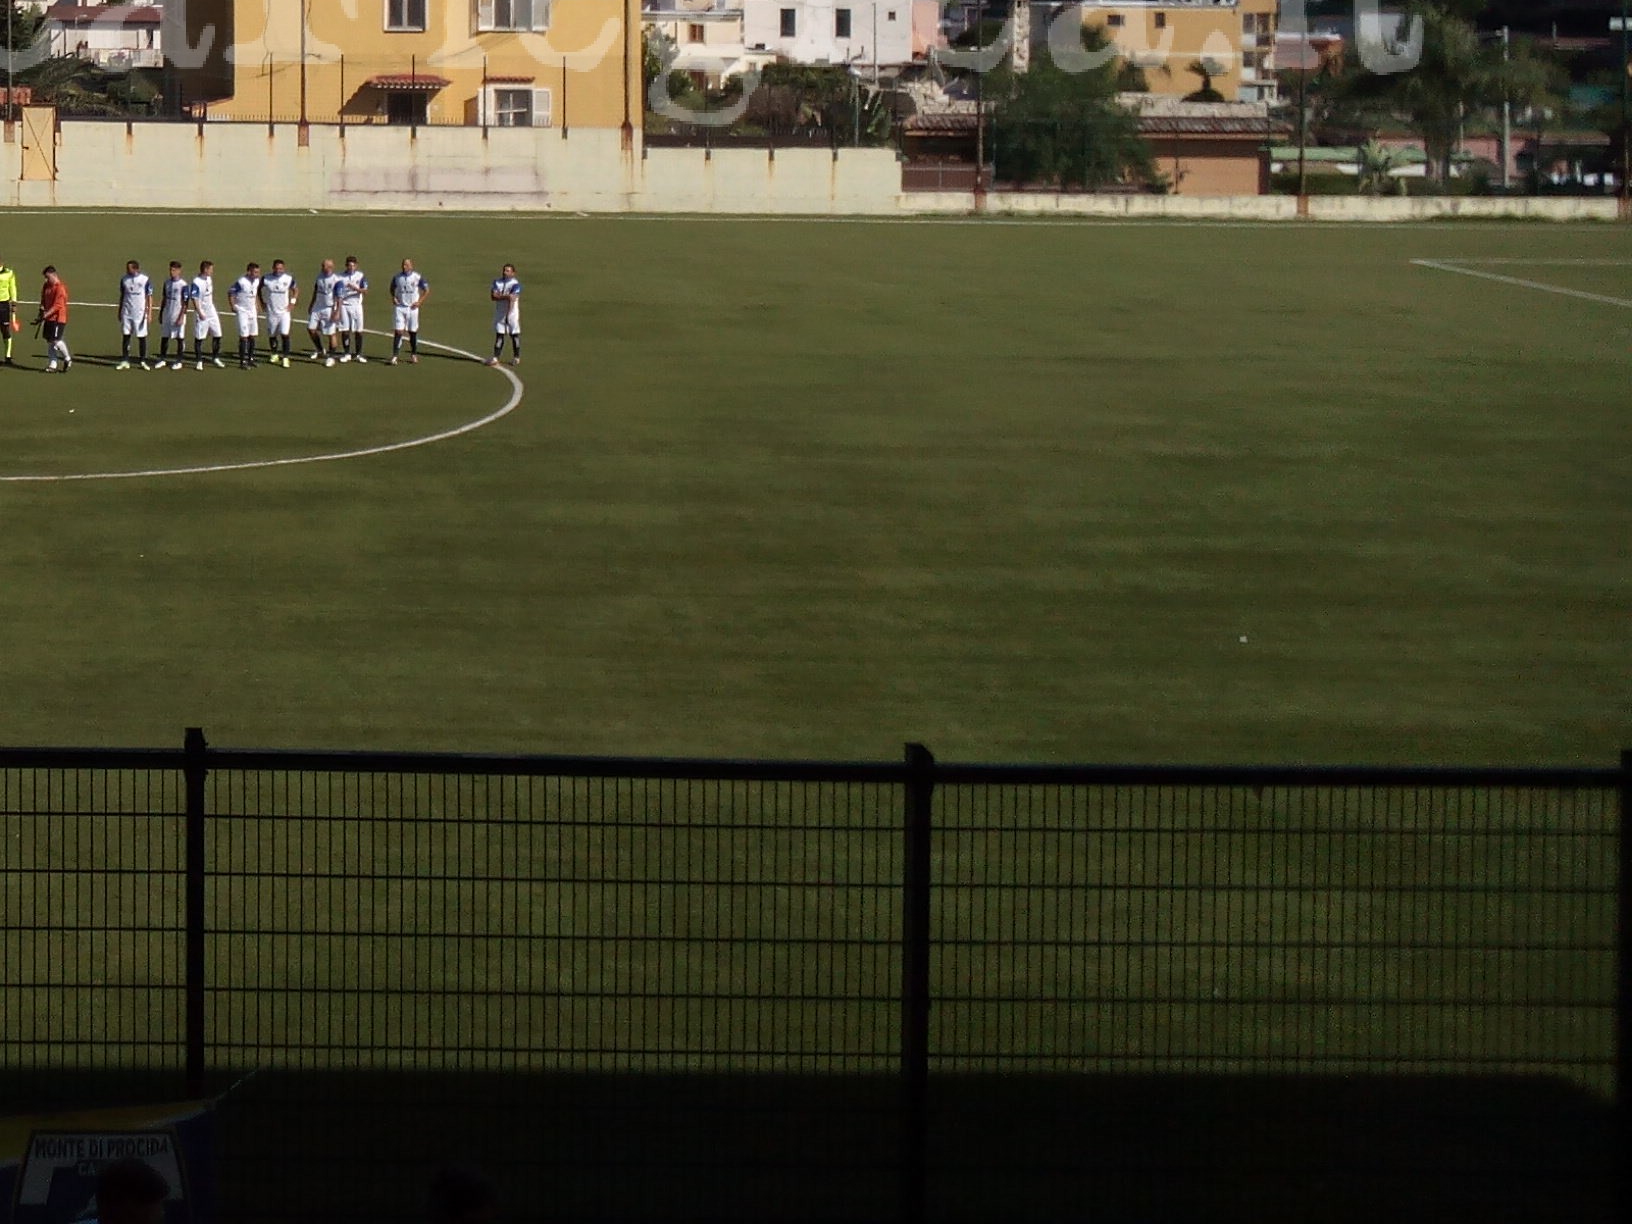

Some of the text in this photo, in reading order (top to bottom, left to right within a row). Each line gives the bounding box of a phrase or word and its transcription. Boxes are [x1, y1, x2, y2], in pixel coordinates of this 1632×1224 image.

[34, 1137, 169, 1158] MONTE DI PROCIDA
